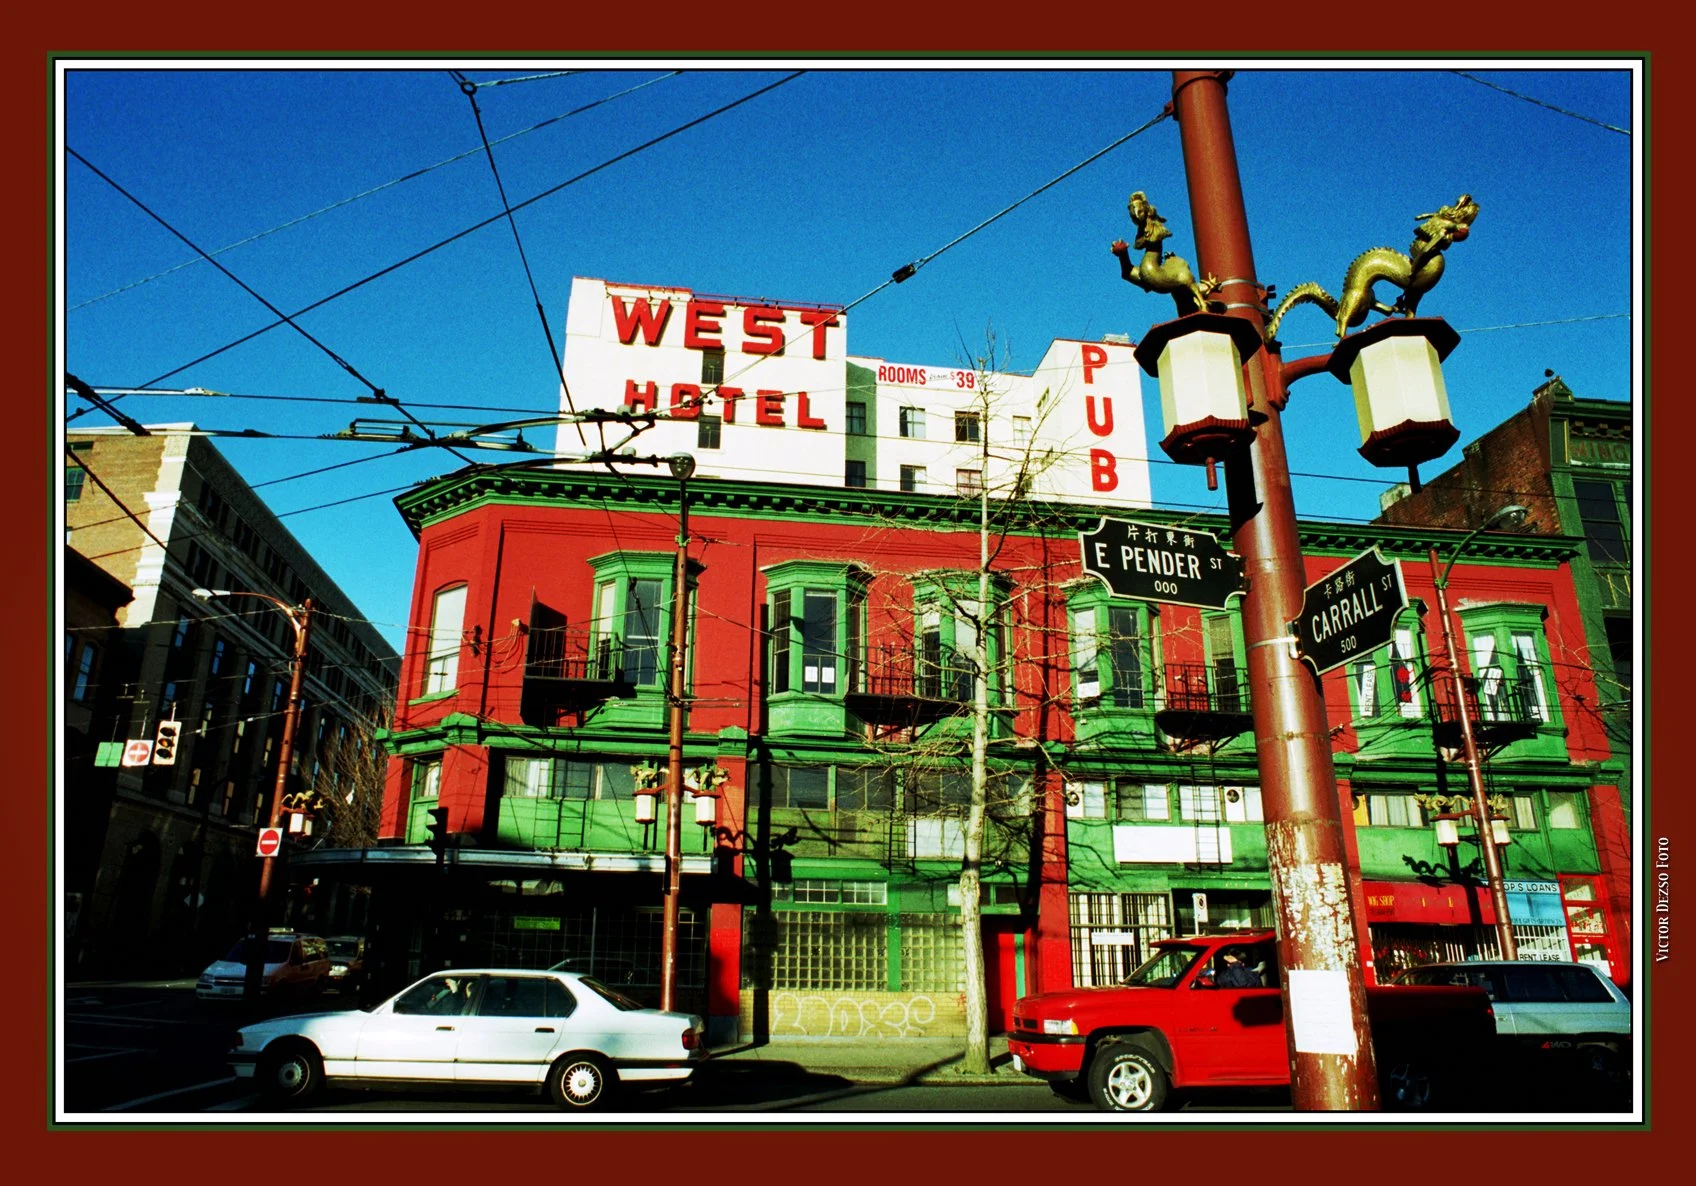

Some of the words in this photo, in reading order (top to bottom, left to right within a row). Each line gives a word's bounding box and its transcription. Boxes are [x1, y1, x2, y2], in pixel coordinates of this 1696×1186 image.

[612, 295, 840, 360] WEST
[878, 365, 927, 385] ROOMS
[623, 379, 828, 429] HOTEL
[1081, 344, 1120, 493] PUB
[1127, 525, 1195, 549] 片打東街
[1095, 542, 1111, 569] E
[1120, 545, 1202, 580] PENDER
[1210, 557, 1222, 570] ST
[1154, 580, 1178, 595] 000
[1312, 582, 1384, 643] CARRALL
[1381, 573, 1392, 591] ST
[1340, 635, 1357, 653] 500
[1526, 883, 1557, 892] LOANS
